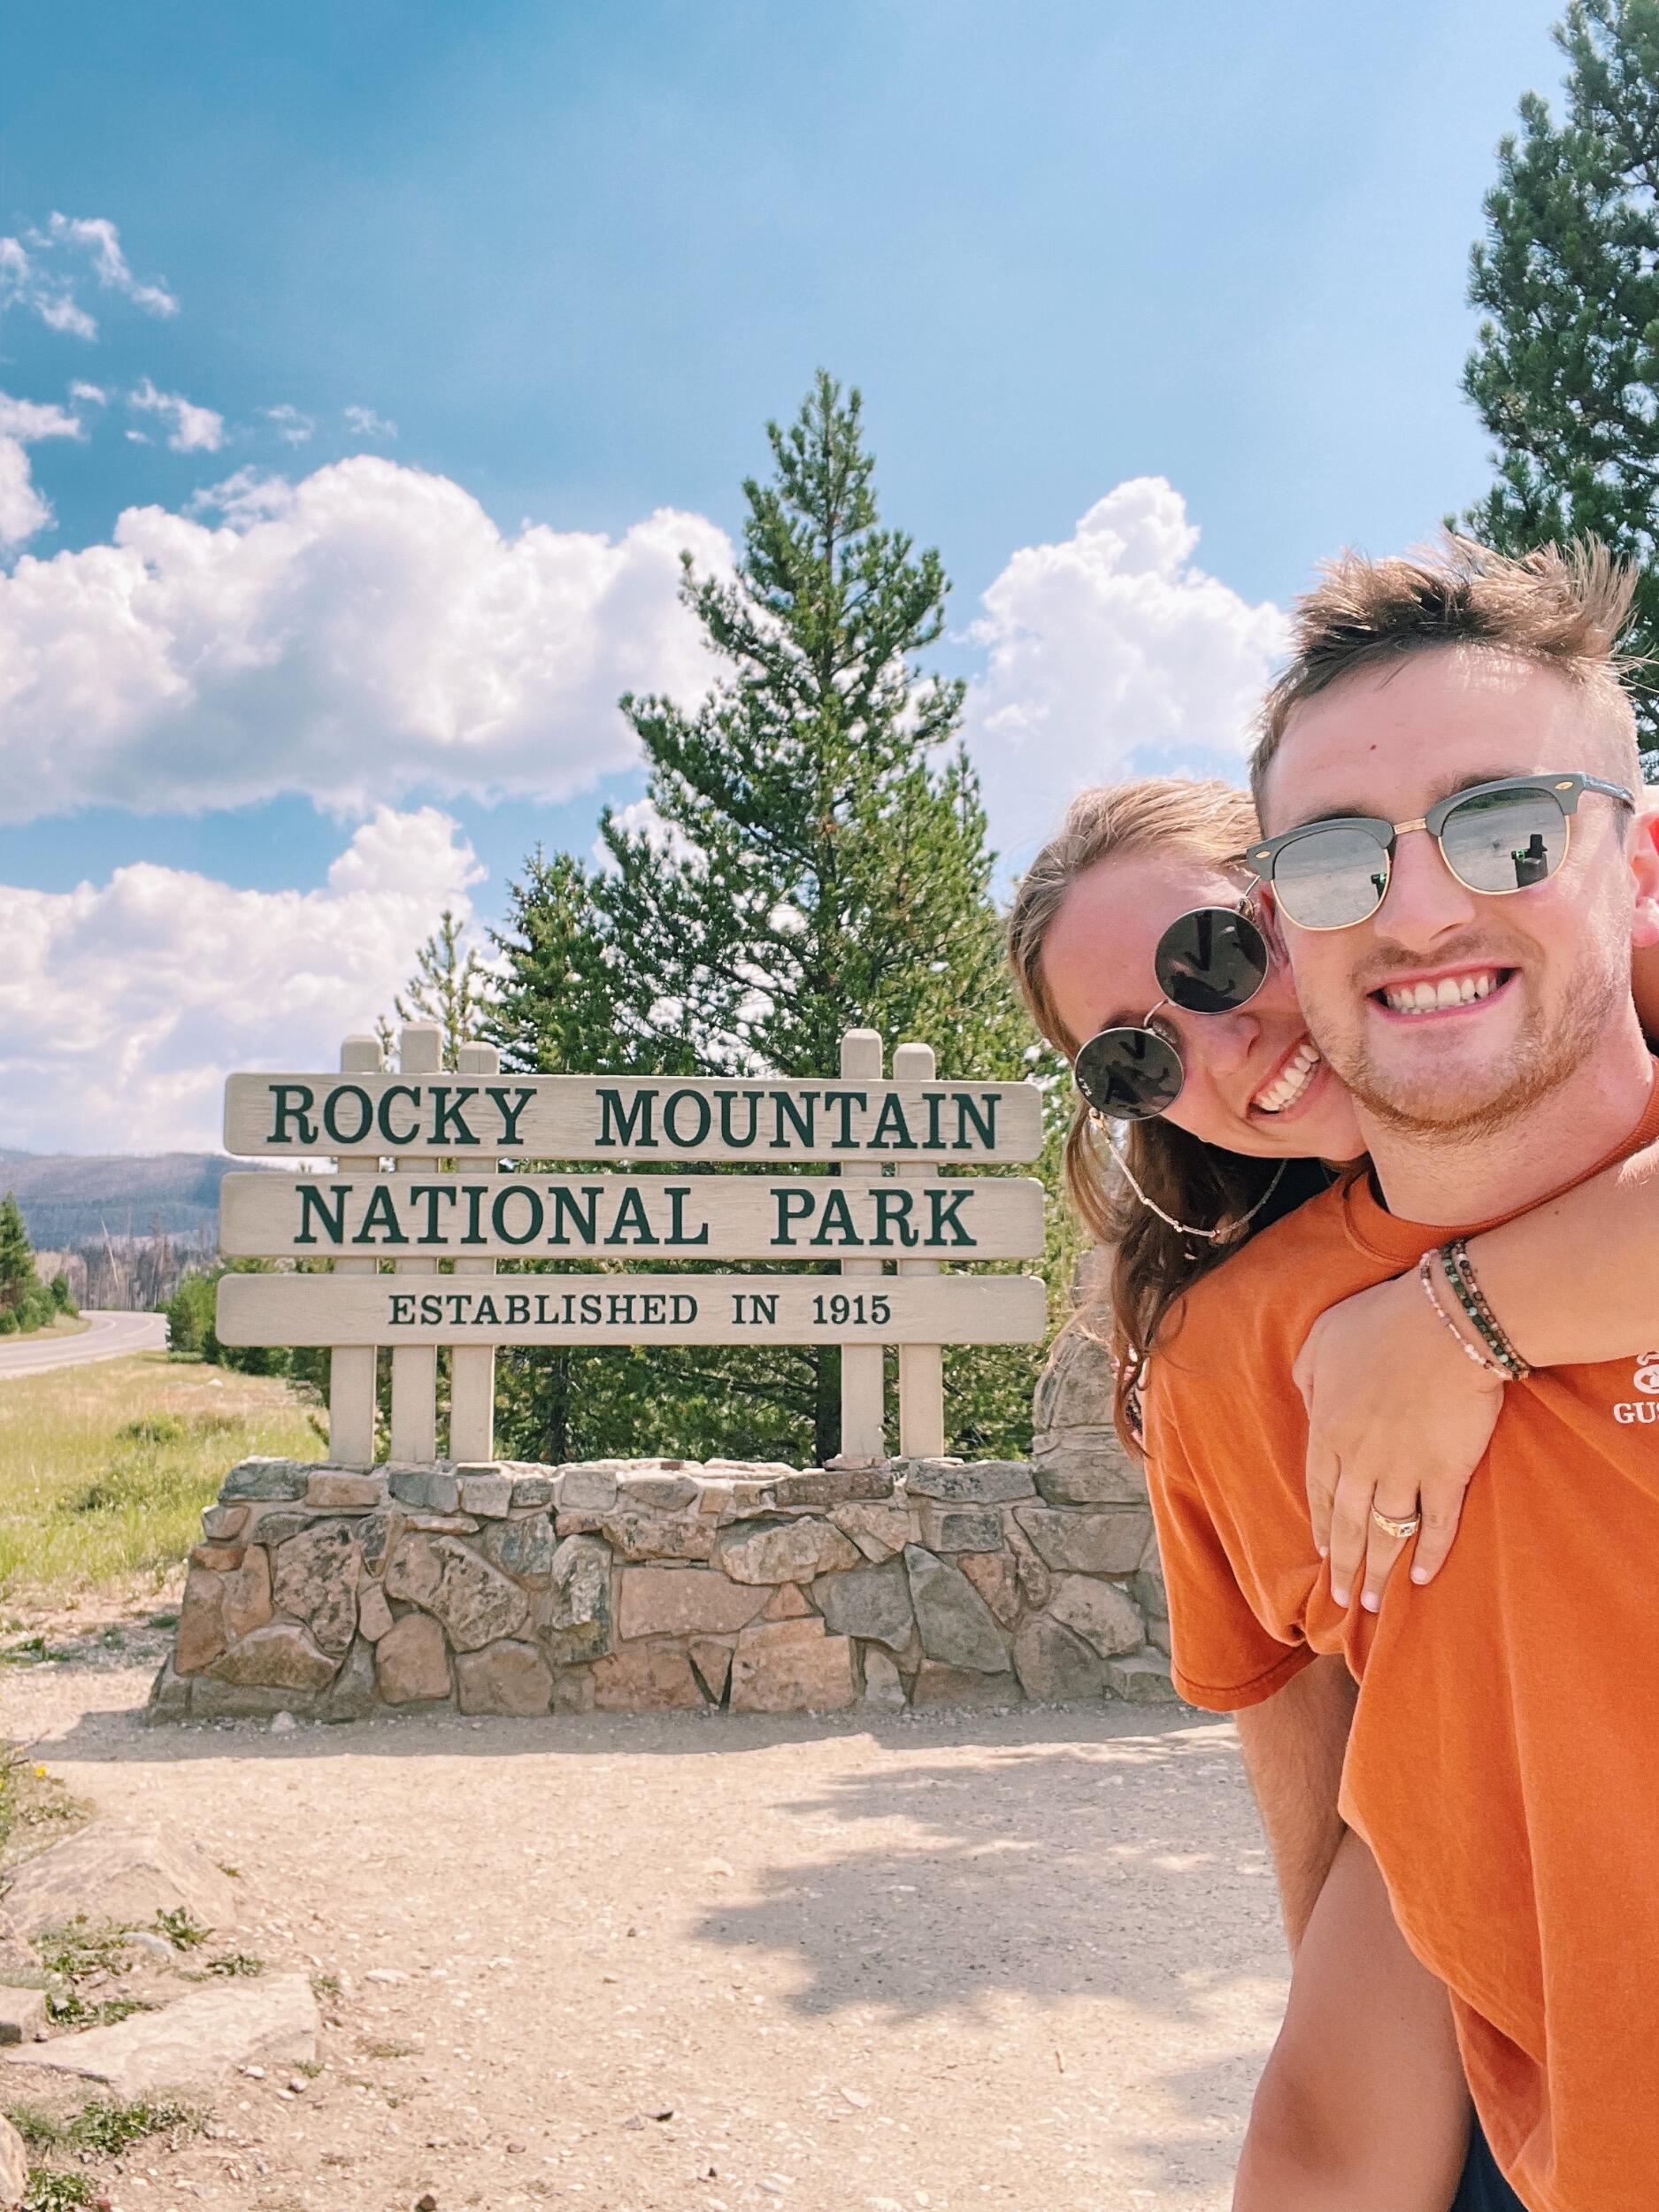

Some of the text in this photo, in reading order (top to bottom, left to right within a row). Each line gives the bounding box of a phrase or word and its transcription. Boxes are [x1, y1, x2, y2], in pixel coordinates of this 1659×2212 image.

[265, 1084, 1002, 1150] ROCKY MOUNTAIN
[293, 1184, 978, 1248] NATIONAL PARK
[388, 1294, 891, 1325] ESTABLISHED IN 1915
[1613, 1402, 1659, 1424] GU
